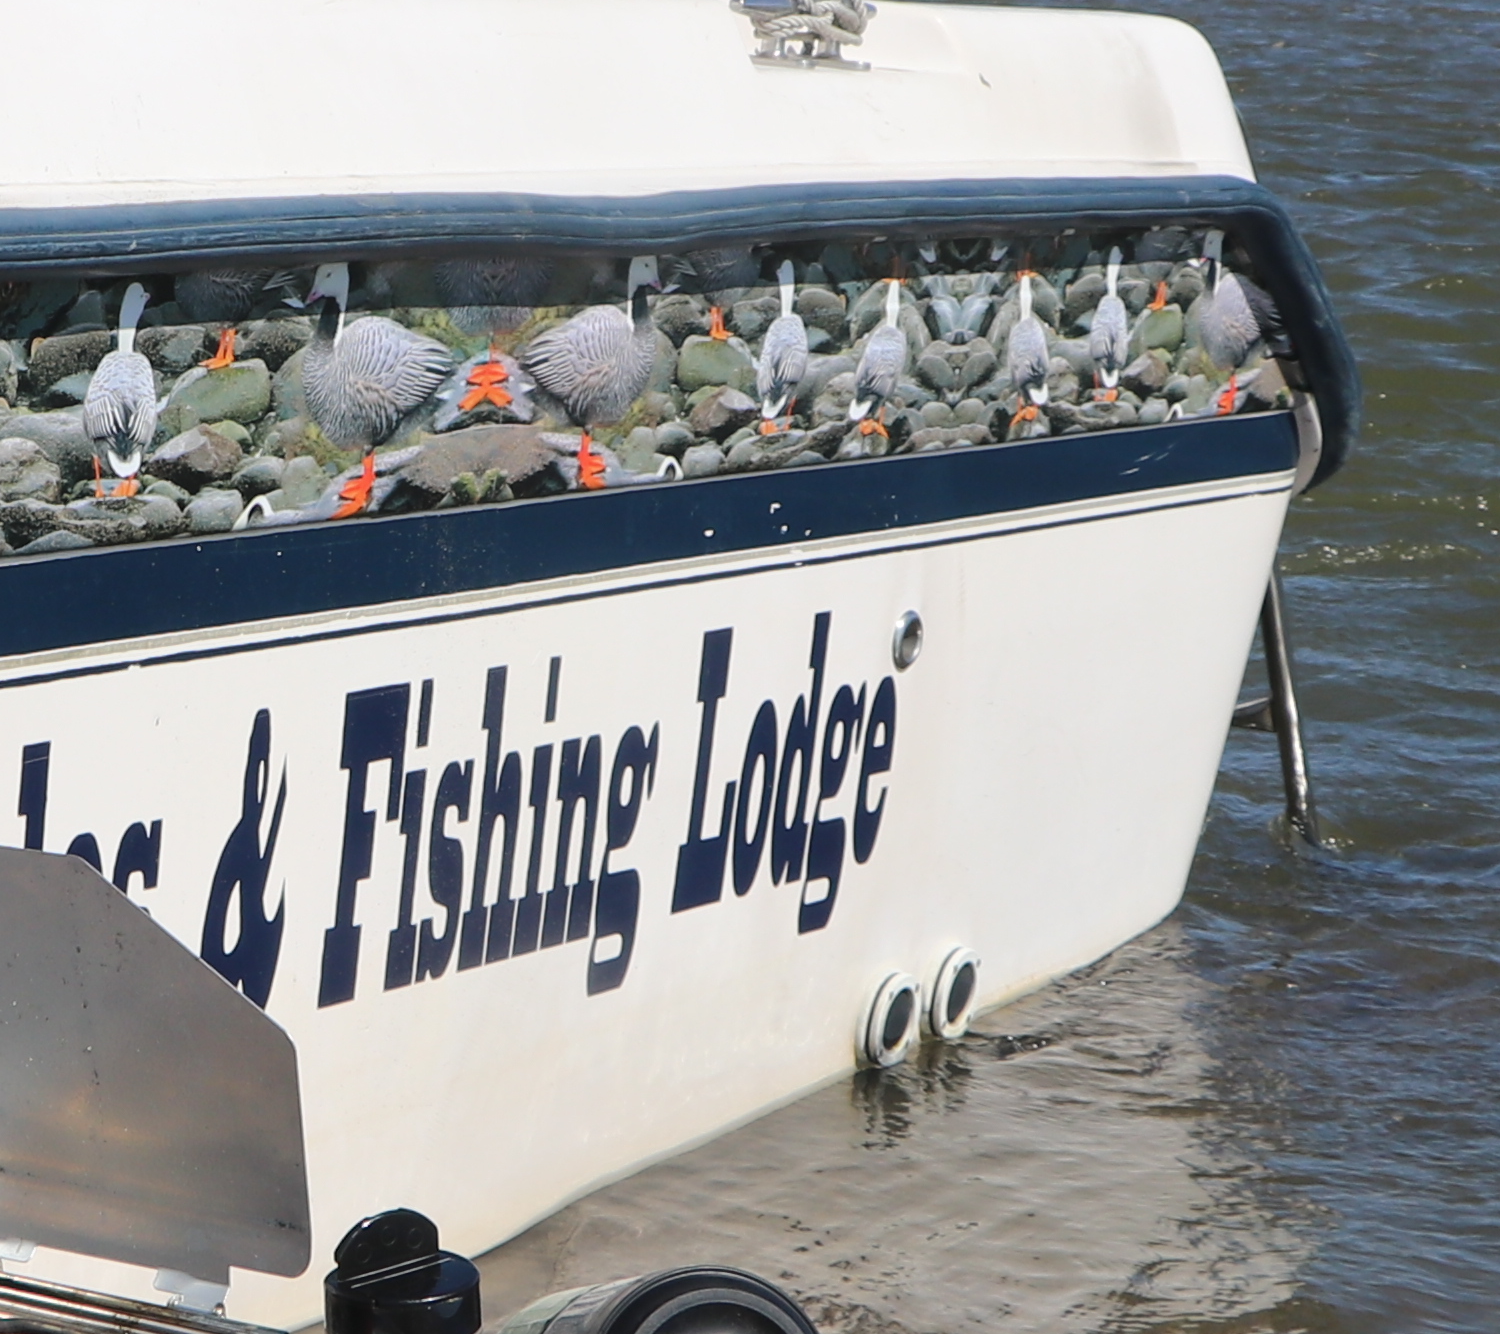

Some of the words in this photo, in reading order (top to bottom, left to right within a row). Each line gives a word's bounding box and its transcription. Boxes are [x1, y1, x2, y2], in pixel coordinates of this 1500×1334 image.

[200, 707, 288, 1011] &
[316, 656, 660, 1010] Fishing
[670, 610, 897, 935] Lodge
